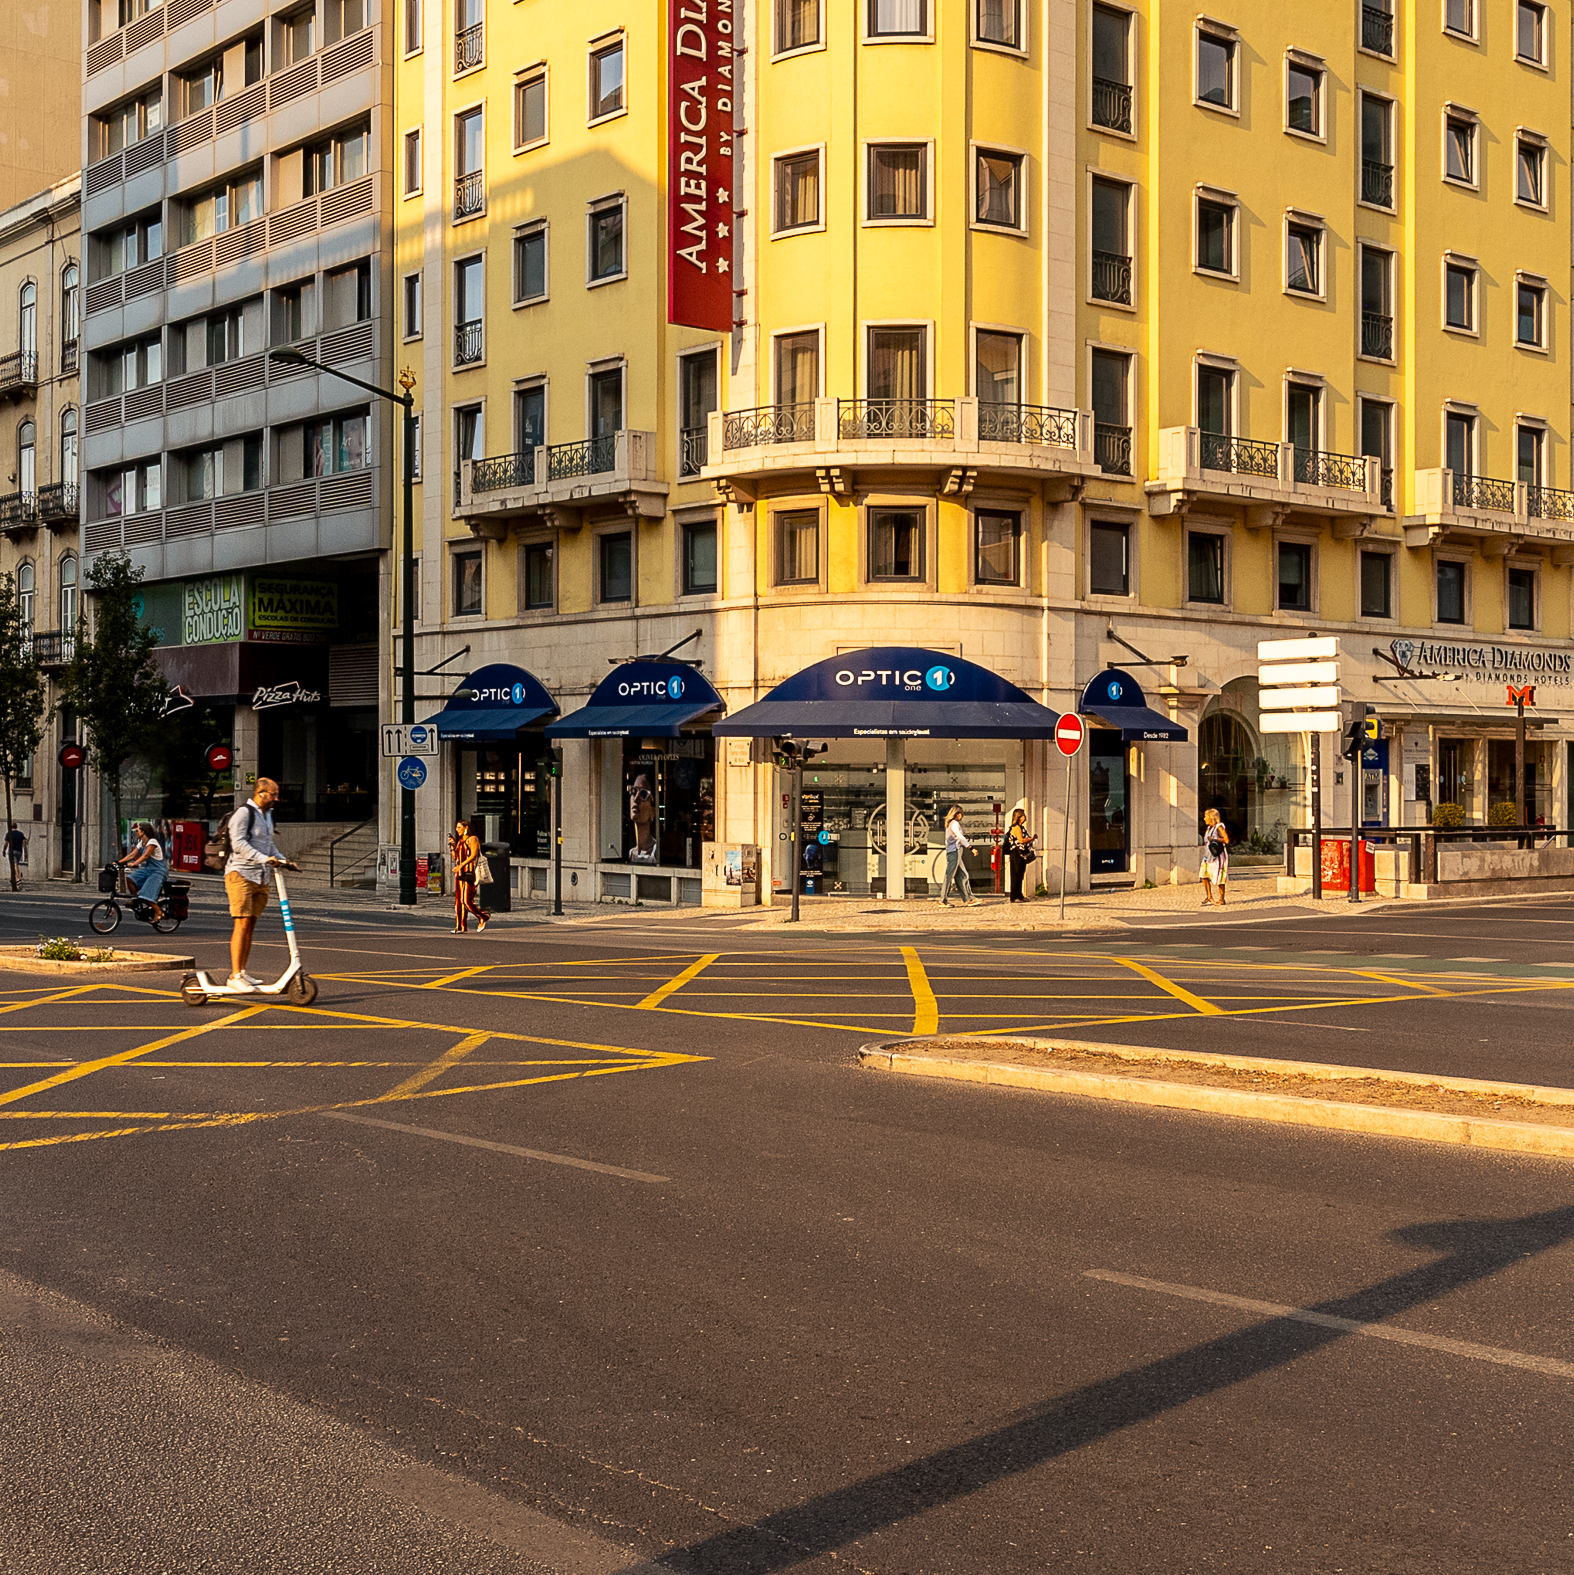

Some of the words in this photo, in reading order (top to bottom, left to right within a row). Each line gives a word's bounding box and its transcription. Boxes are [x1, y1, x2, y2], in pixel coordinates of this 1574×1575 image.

[720, 131, 732, 156] BY
[676, 76, 707, 274] AMERICA
[185, 573, 240, 617] ESCOLA
[257, 582, 336, 598] SEGURANÇA
[257, 594, 336, 616] MÁXIMA
[185, 606, 242, 644] CONDUÇÃO
[261, 630, 281, 641] VERDE
[1417, 641, 1488, 668] AMERICA
[1490, 646, 1572, 673] DIAMONDS
[835, 670, 922, 686] OPTIC
[1476, 672, 1528, 684] DIAMONDS
[1534, 675, 1571, 686] HOTELS
[252, 686, 291, 703] Pizza
[471, 687, 510, 701] OPTIC
[618, 680, 666, 696] OPTIC
[1506, 685, 1533, 706] M
[657, 753, 680, 761] PEOPLES
